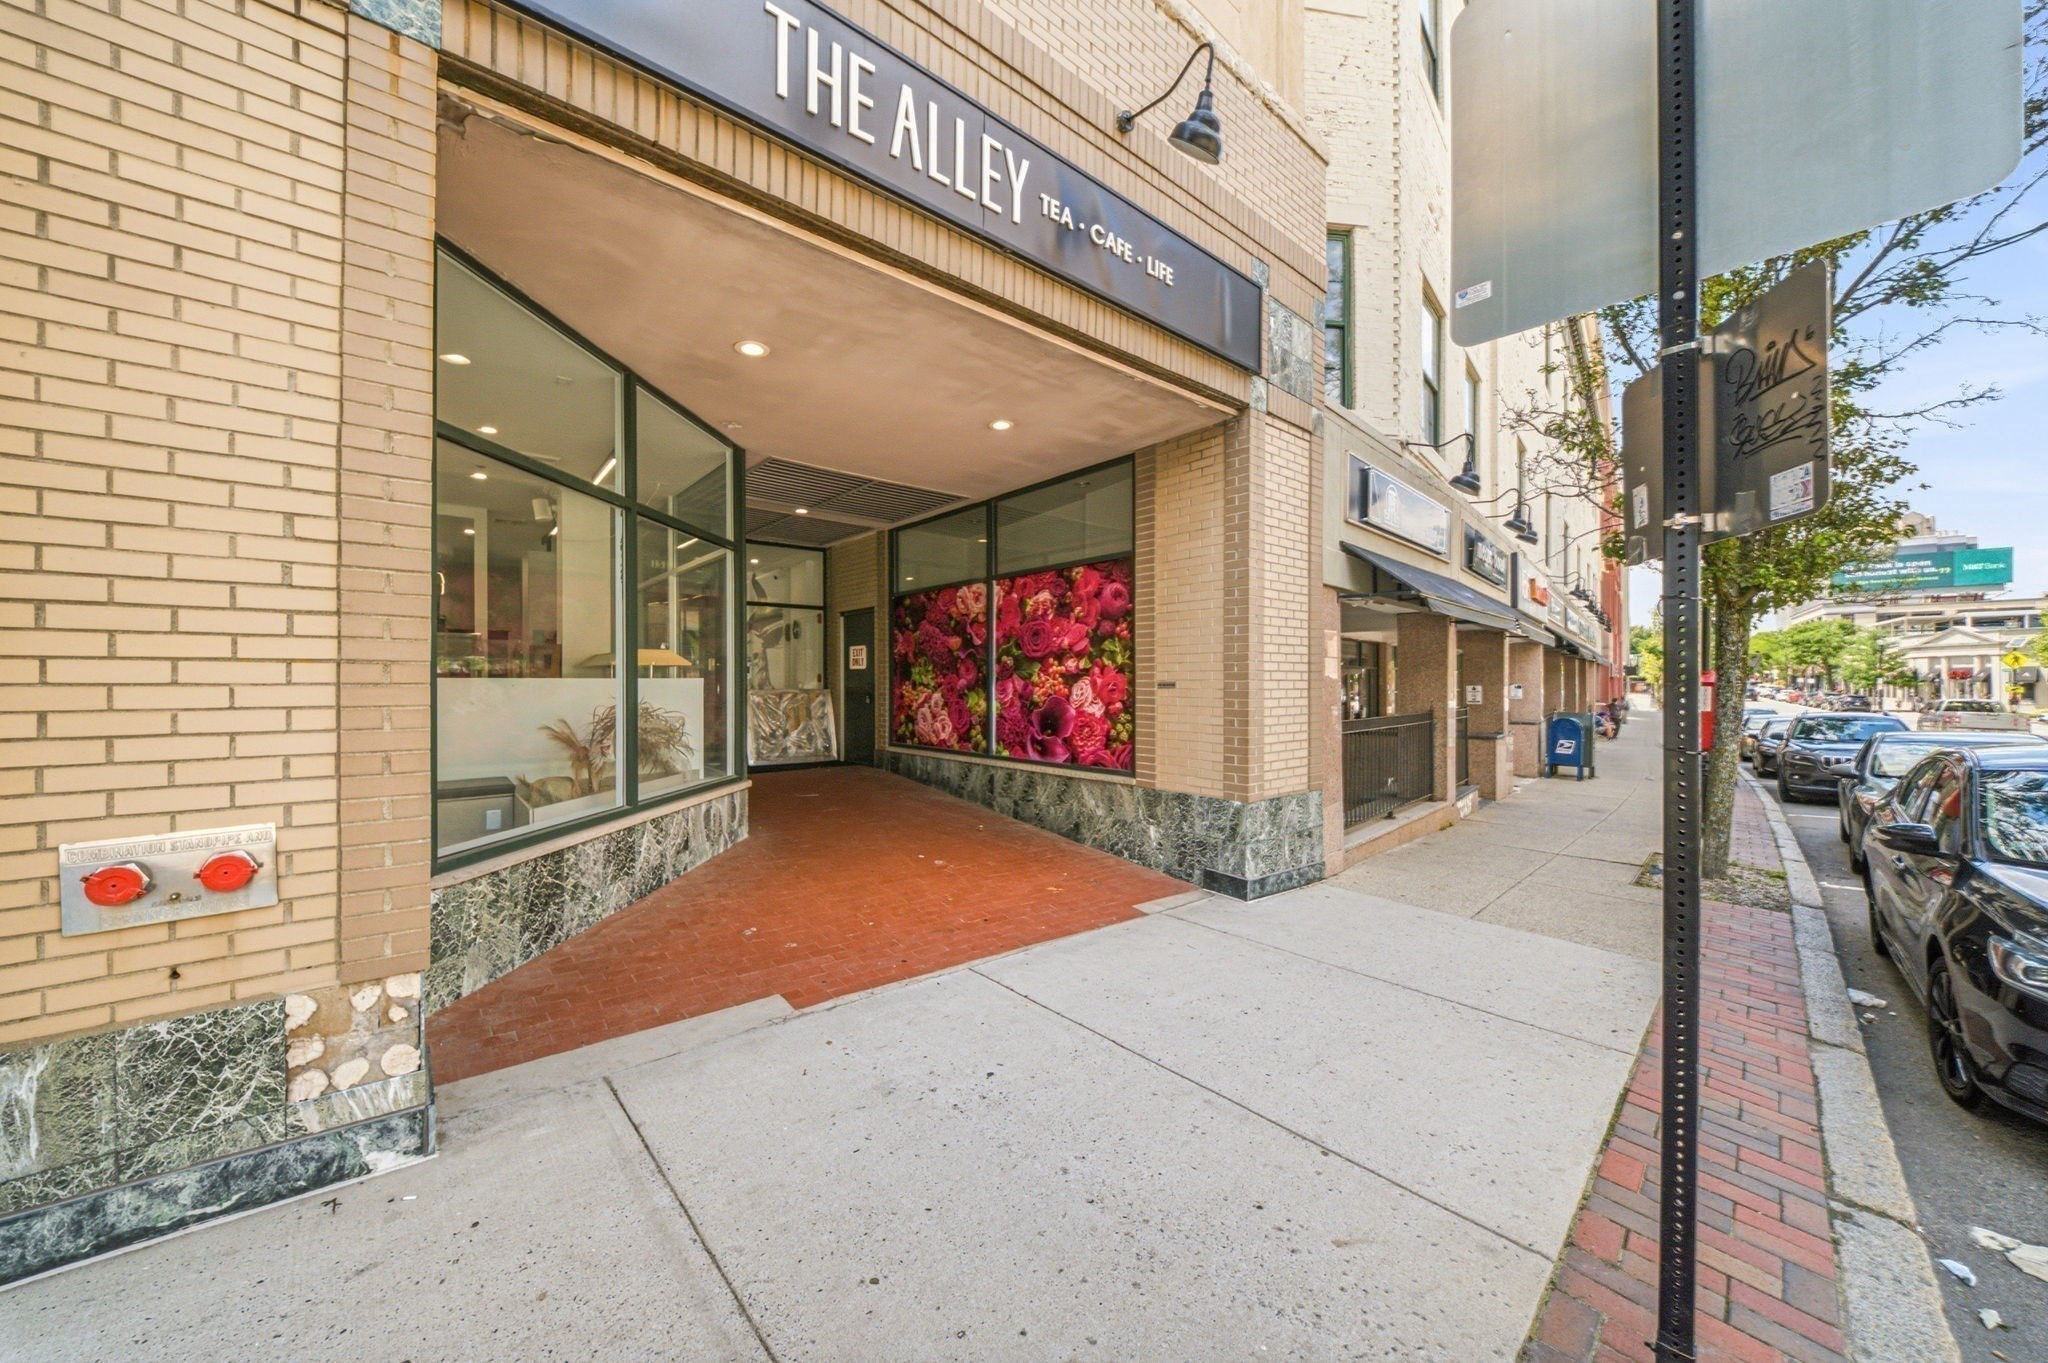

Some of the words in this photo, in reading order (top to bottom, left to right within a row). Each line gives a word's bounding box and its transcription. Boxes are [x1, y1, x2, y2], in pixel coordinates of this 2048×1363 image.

[764, 1, 876, 145] THE
[889, 83, 1030, 224] ALLEY
[1039, 192, 1074, 231] TEA
[1089, 223, 1133, 264] CAFE
[1145, 255, 1175, 287] LIFE
[852, 648, 864, 657] EXIT
[852, 658, 864, 666] ONLY
[66, 841, 166, 863] COMBINATION
[169, 833, 242, 851] STANDPIPE
[247, 829, 274, 843] AND
